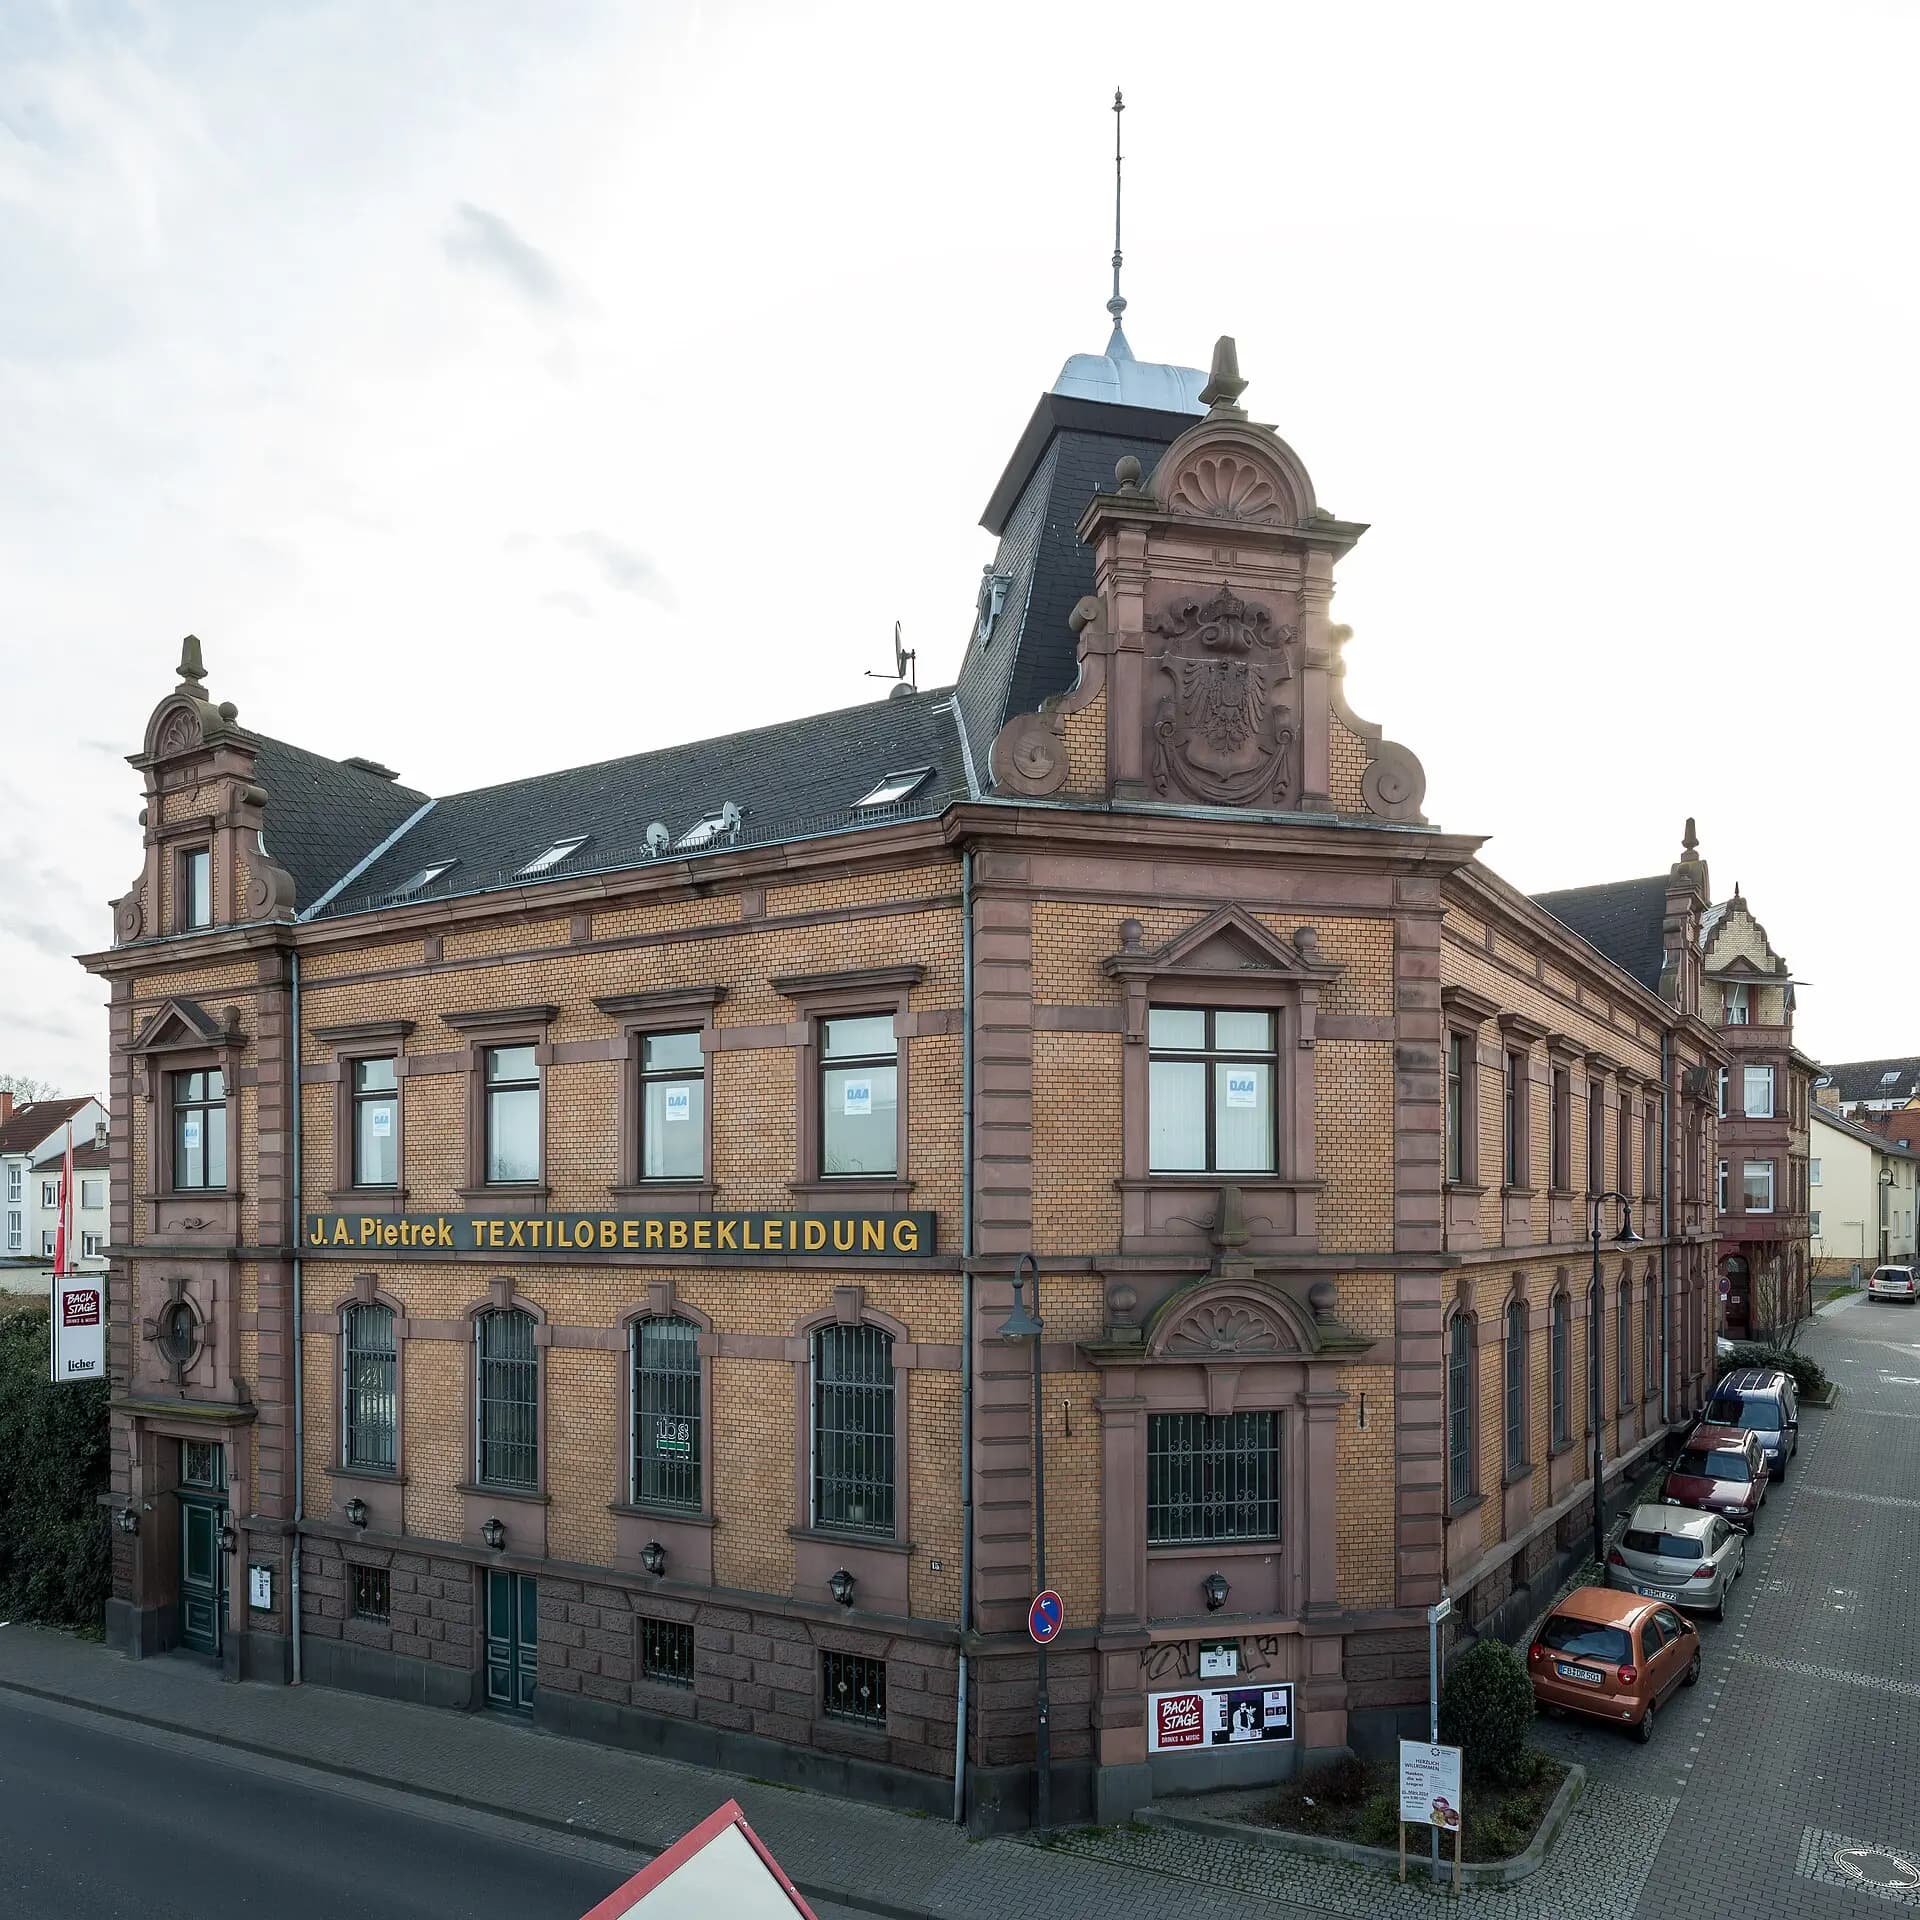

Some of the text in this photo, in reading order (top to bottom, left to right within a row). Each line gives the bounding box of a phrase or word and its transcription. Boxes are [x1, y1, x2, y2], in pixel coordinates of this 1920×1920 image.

[360, 1217, 454, 1247] Pietrek
[471, 1219, 919, 1251] TEXTILOBERBEKLEIDUNG
[66, 1291, 95, 1305] BACK
[68, 1302, 97, 1314] STAGE
[68, 1359, 96, 1372] Licher
[1161, 1697, 1197, 1717] BACK
[1163, 1711, 1200, 1730] STAGE
[1162, 1735, 1178, 1744] DRINKS
[1405, 1763, 1440, 1771] WILLKOMMEN
